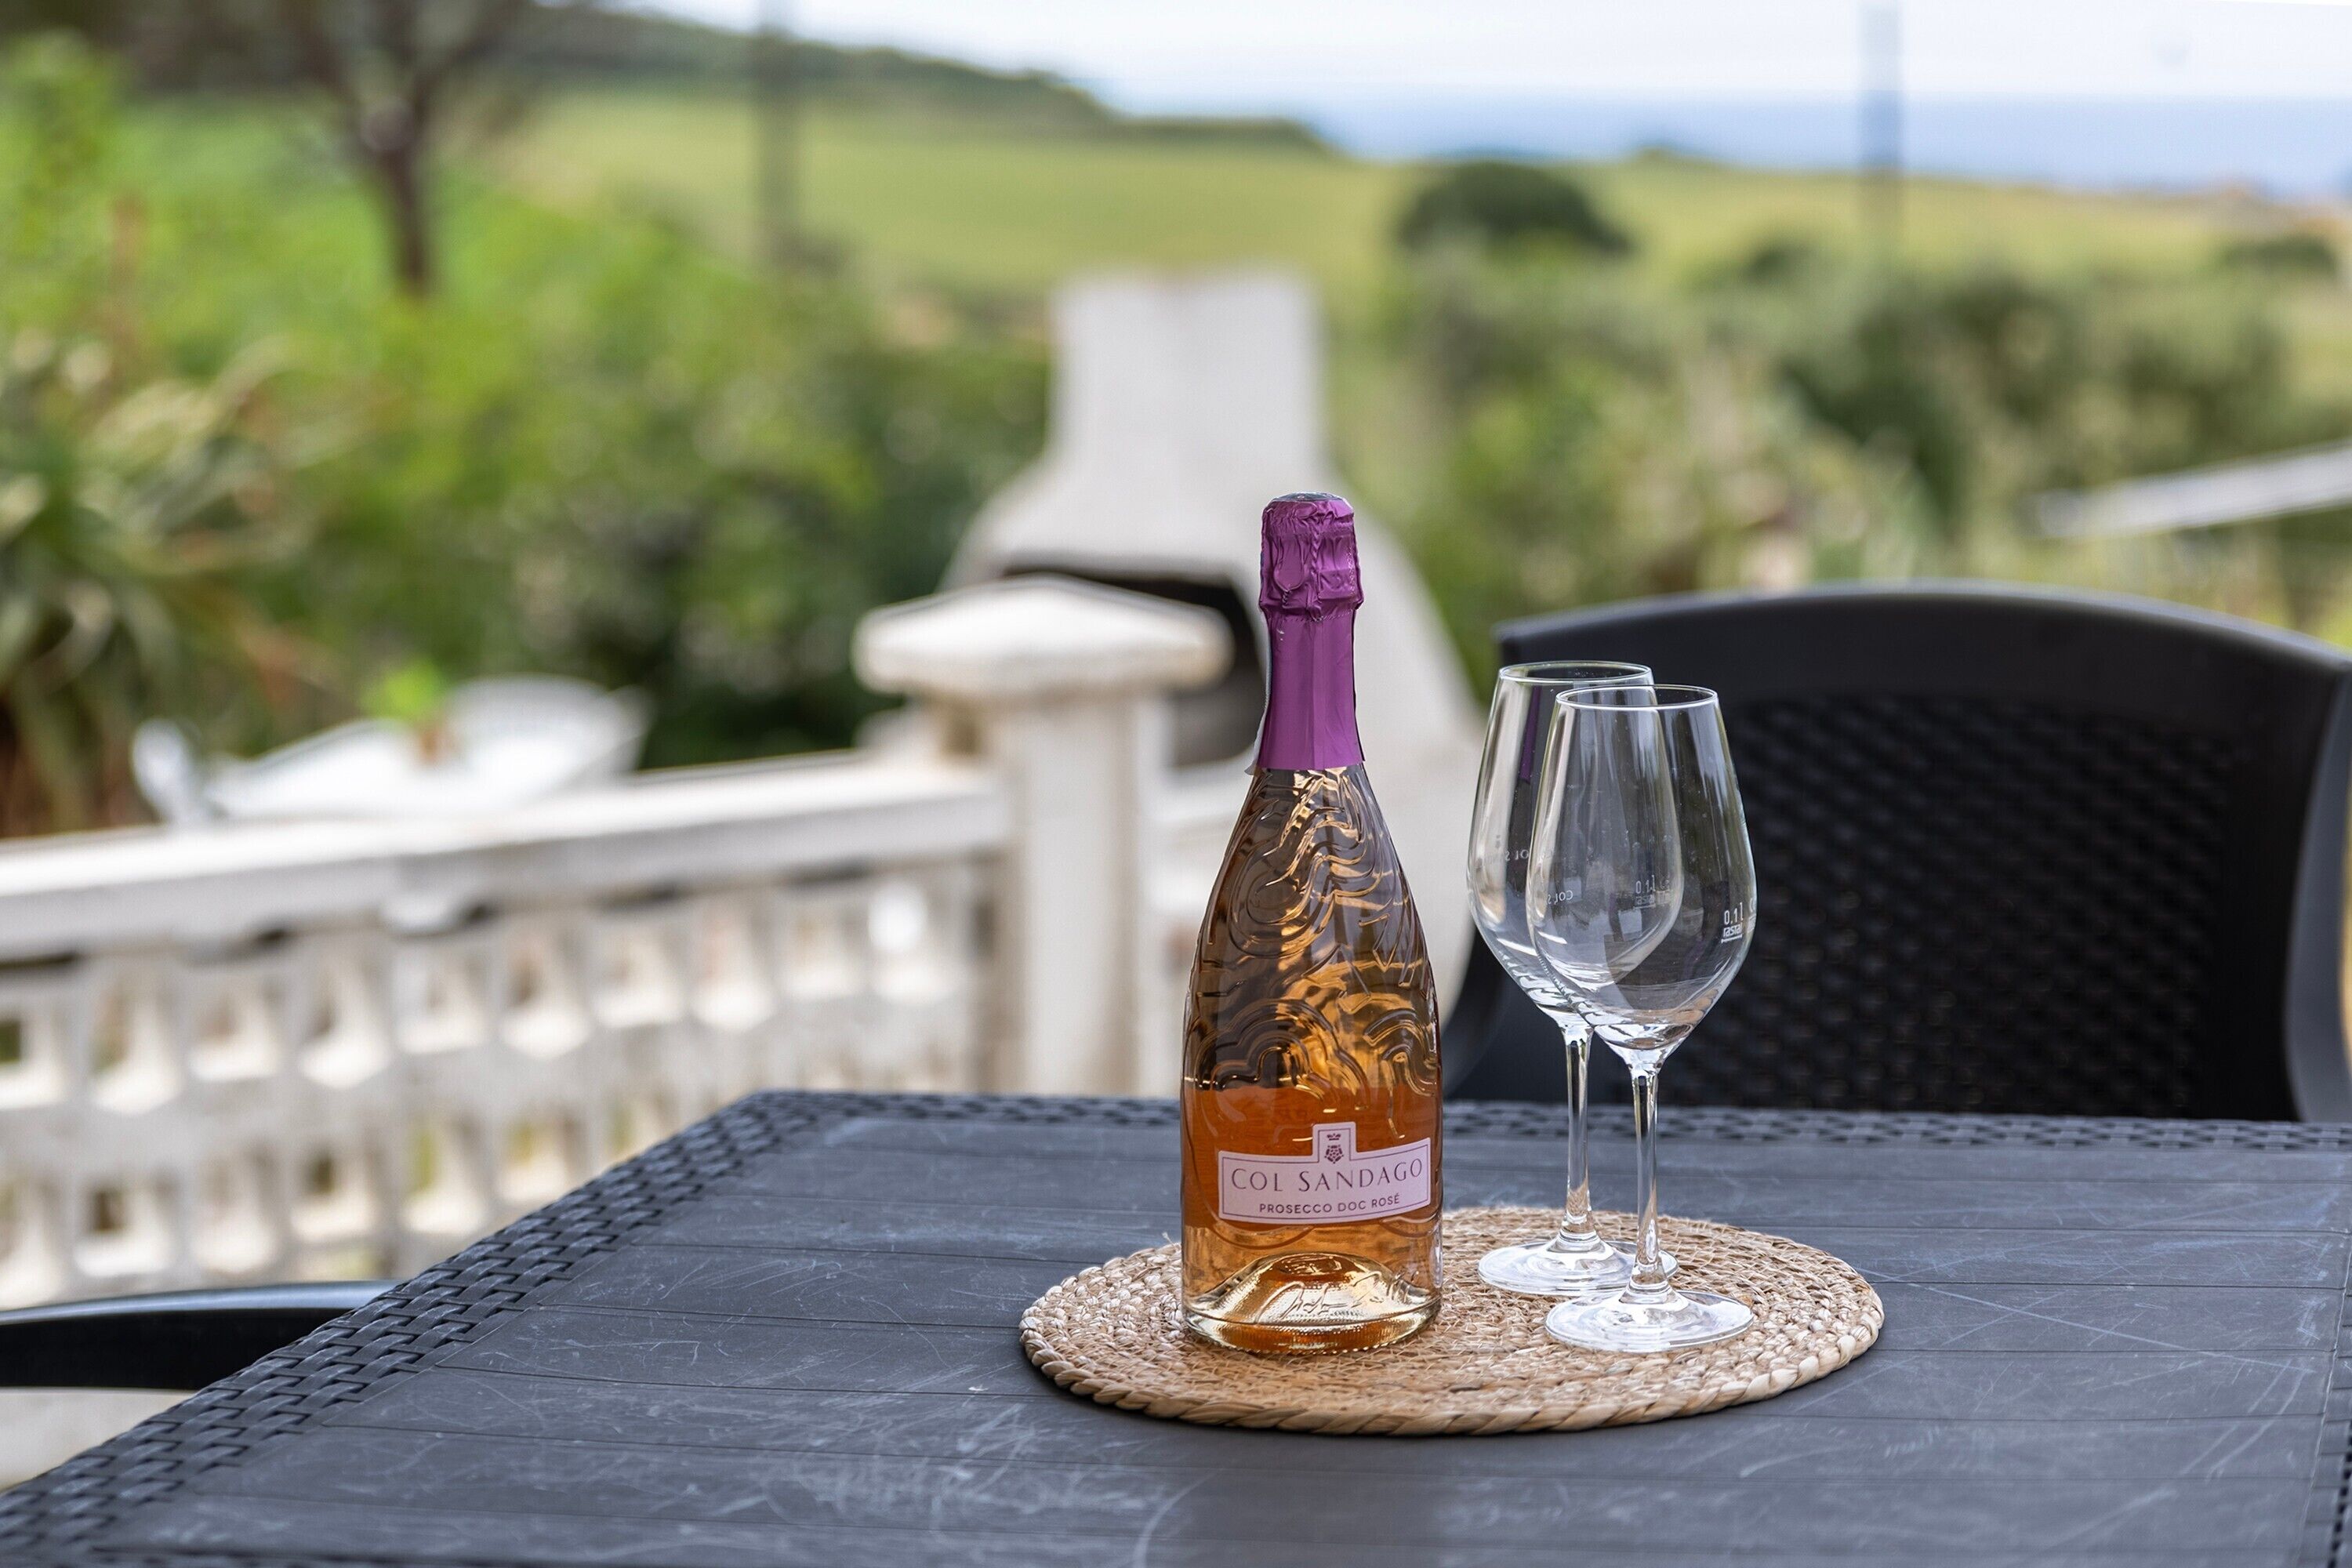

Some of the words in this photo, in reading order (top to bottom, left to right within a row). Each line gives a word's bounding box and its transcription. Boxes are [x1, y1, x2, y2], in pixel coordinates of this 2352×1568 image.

[1232, 1167, 1283, 1192] COL
[1298, 1158, 1422, 1192] SANDAGO
[1259, 1203, 1332, 1214] PROSECCO
[1338, 1200, 1367, 1212] DOC
[1371, 1192, 1399, 1208] ROSÉ
